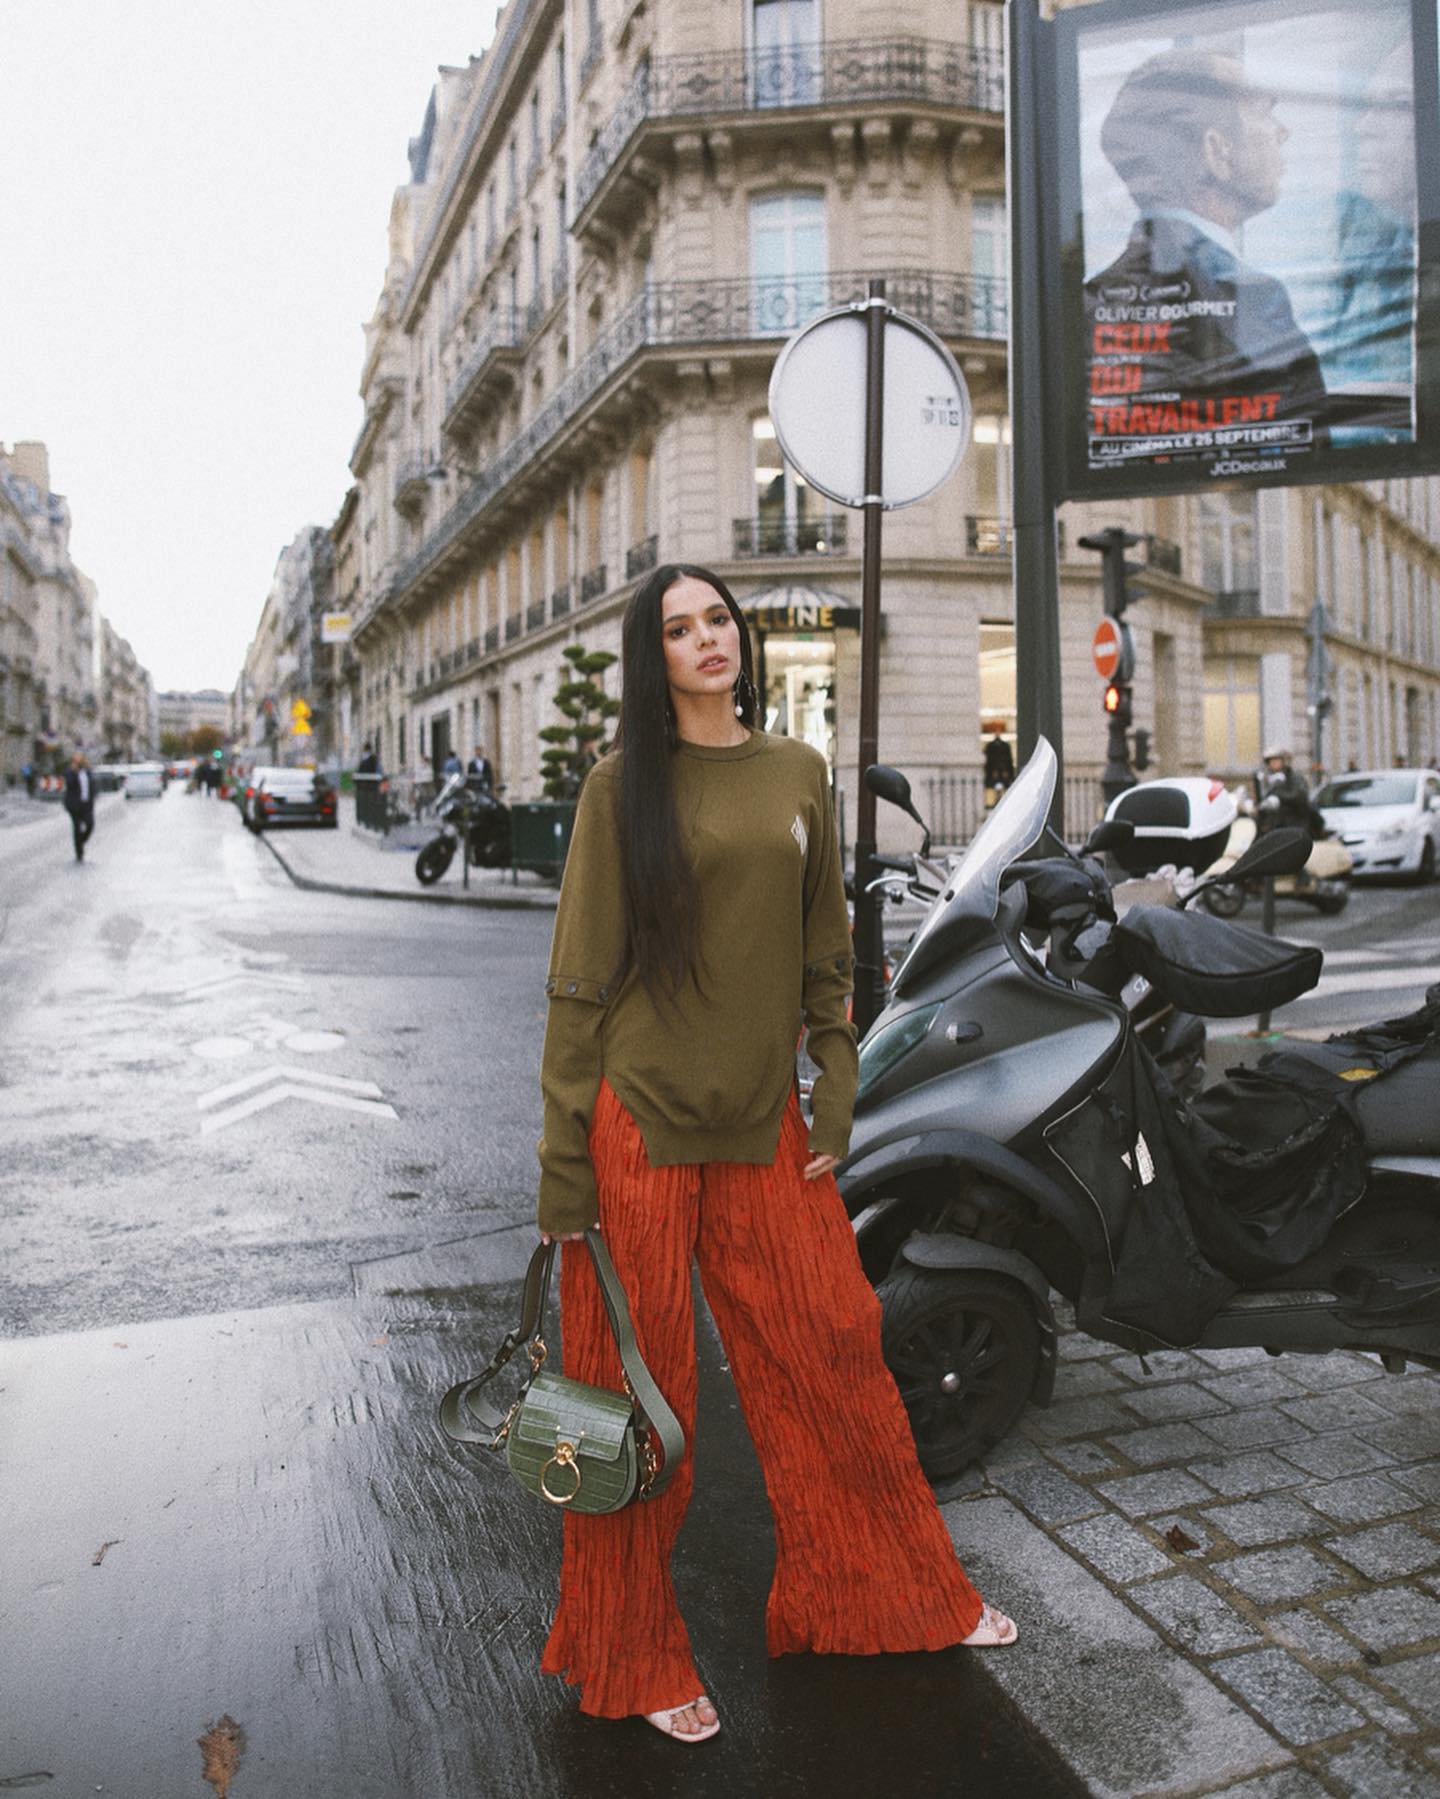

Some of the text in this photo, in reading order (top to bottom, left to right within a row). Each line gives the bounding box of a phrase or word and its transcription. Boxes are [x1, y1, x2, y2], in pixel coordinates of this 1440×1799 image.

[1095, 300, 1236, 322] OLIVIER GOURMET
[1094, 321, 1170, 353] CEUX
[1090, 393, 1281, 434] TRAVAILLENT
[1210, 459, 1287, 477] JCDecaux
